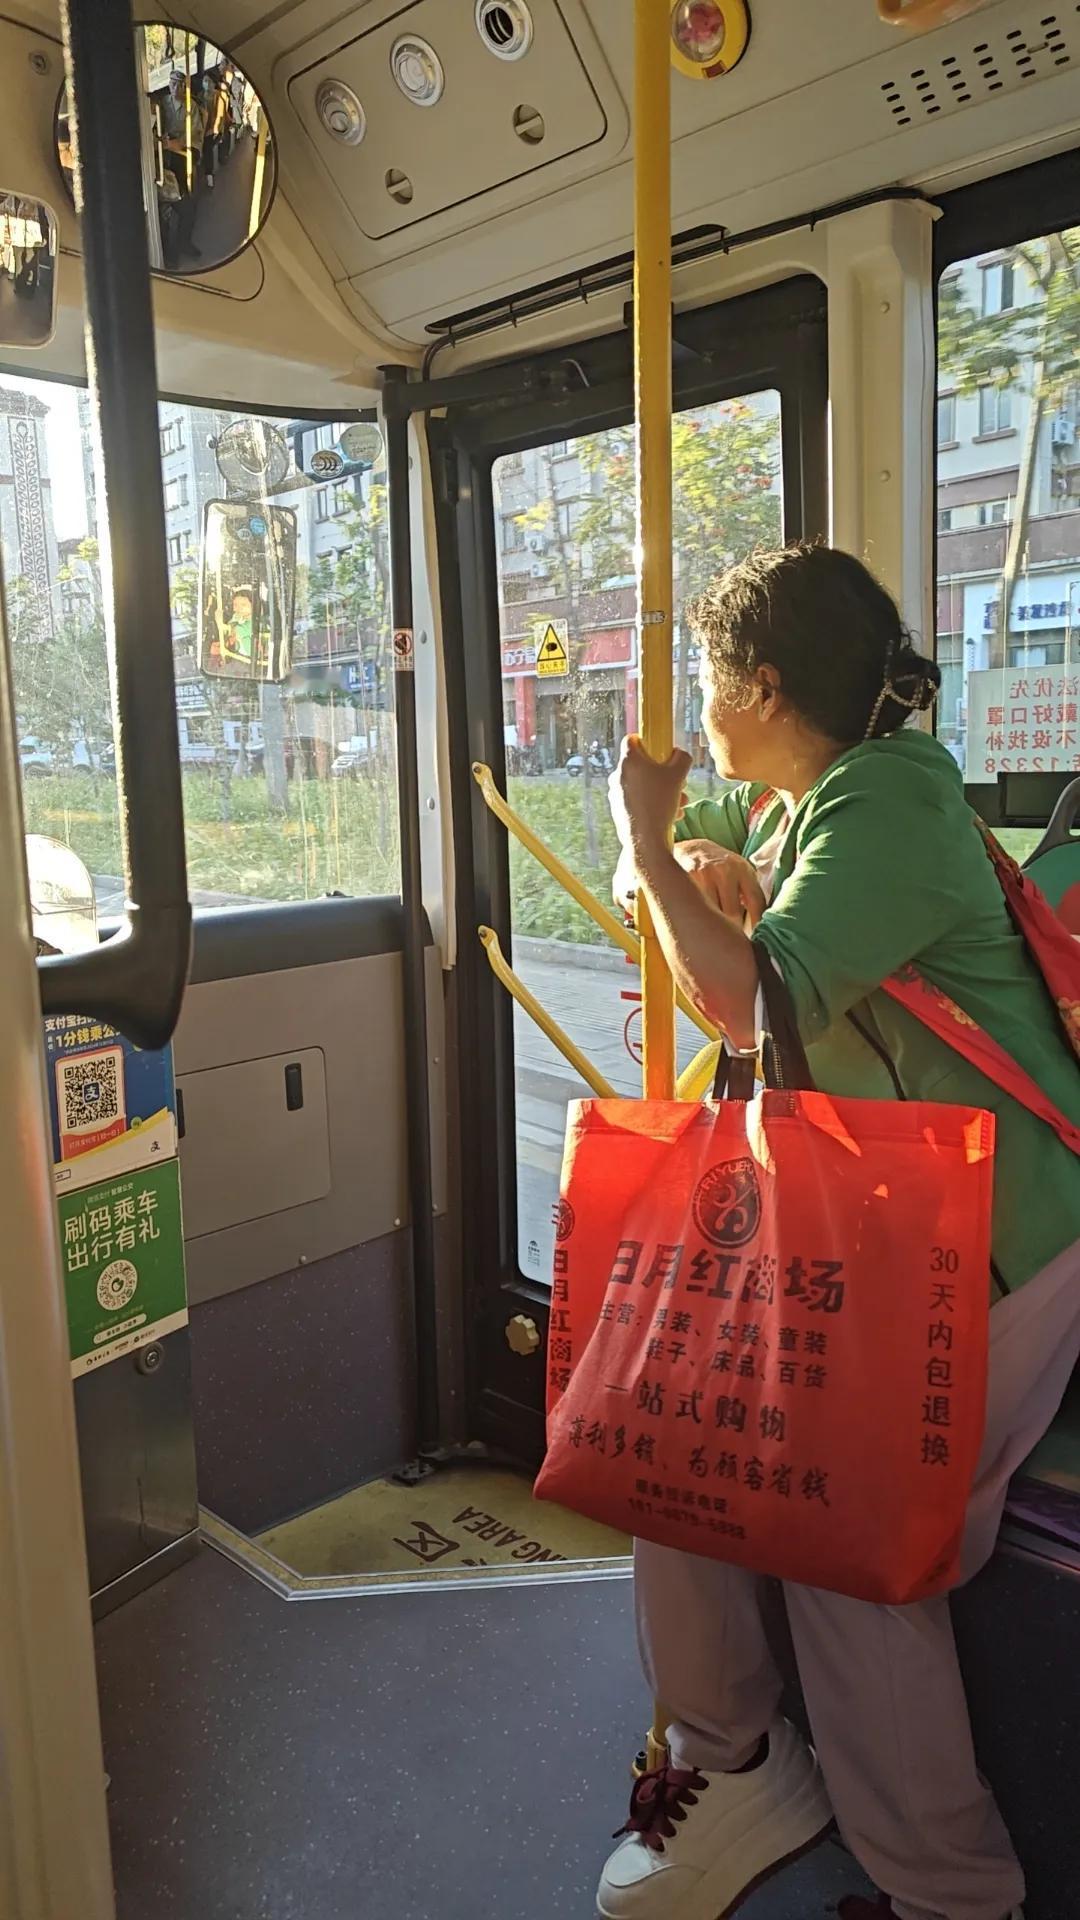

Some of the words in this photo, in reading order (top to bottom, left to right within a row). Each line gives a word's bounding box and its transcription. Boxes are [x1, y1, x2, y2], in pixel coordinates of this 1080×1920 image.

[56, 1023, 120, 1048] 1分钱乘公
[64, 1189, 159, 1245] 刷码乘车
[67, 1215, 160, 1272] 出行有礼
[609, 1240, 845, 1313] 日月红商场
[550, 1248, 573, 1393] 日月红商场
[921, 1246, 960, 1467] 30天内包退换
[605, 1379, 786, 1443] 一站式购物
[452, 1505, 528, 1548] AREA
